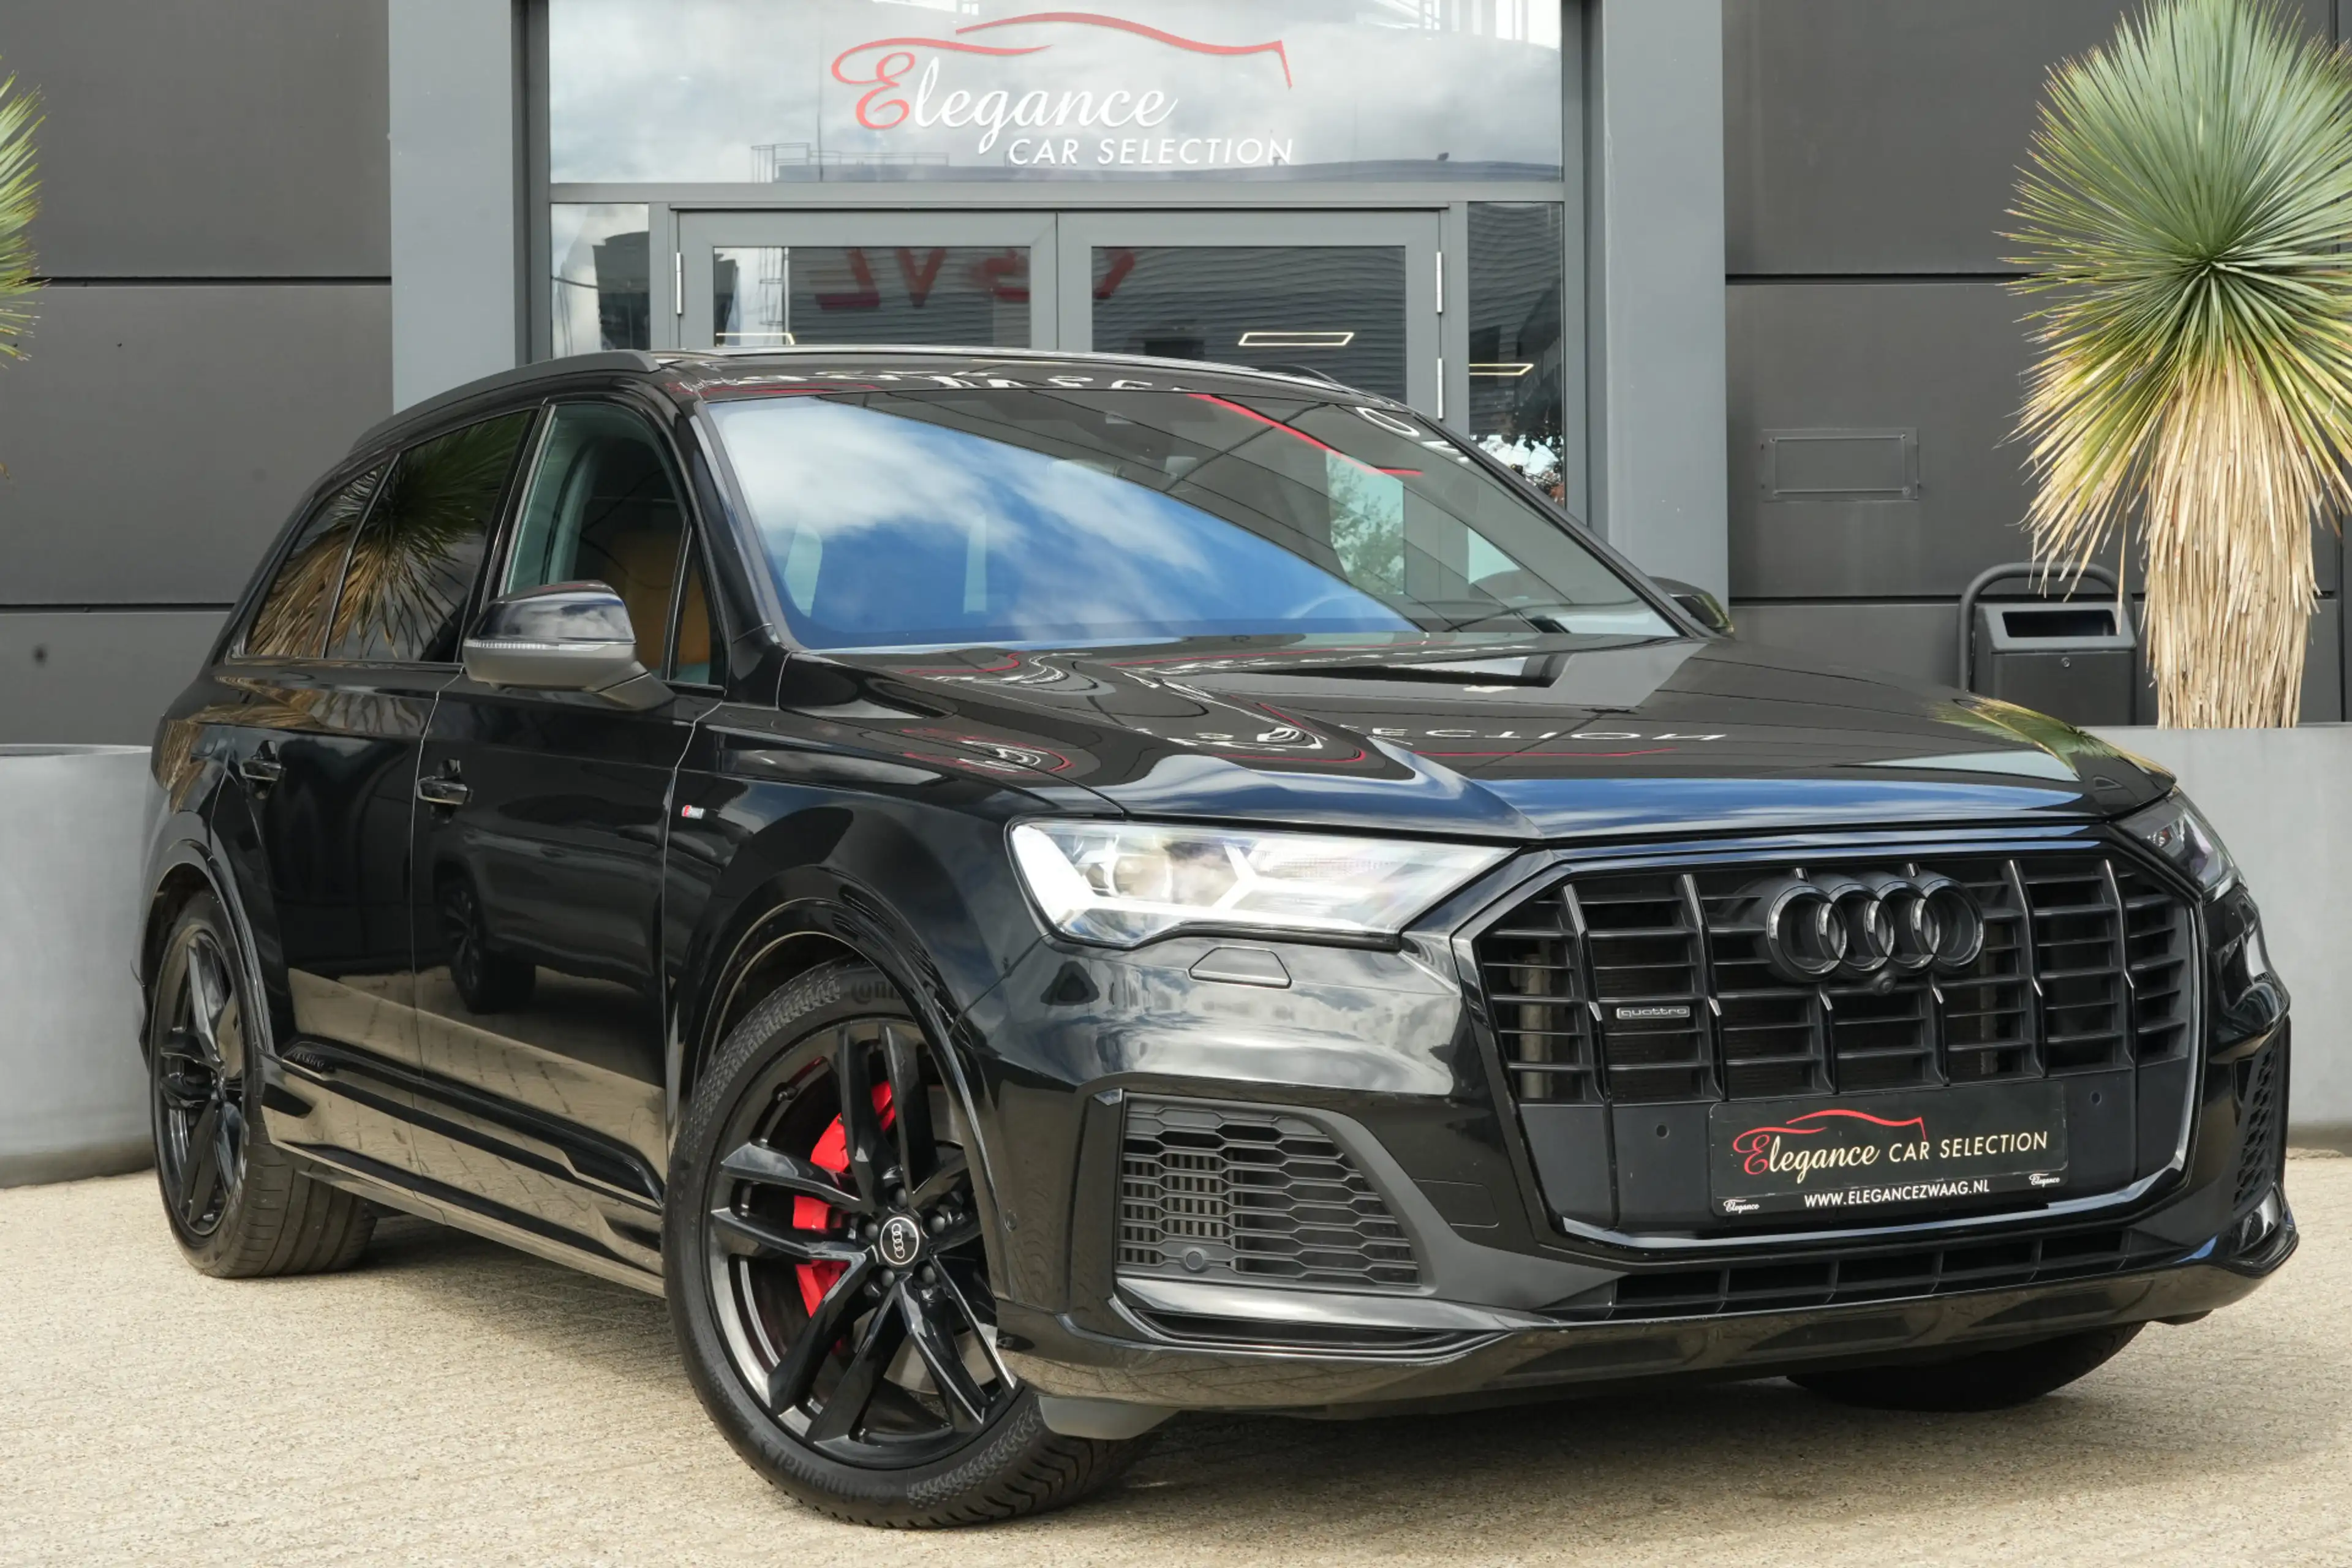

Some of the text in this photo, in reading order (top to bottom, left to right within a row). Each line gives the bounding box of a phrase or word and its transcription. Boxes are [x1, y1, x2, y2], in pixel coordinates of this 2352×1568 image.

[831, 38, 1178, 155] Elegance
[1009, 138, 1293, 165] CAR SELECTION
[1621, 1008, 1687, 1017] quattro
[1733, 1127, 2049, 1184] Elegance CAR SELECTION
[1804, 1178, 1991, 1208] WWW.ELEGANCEZWAAG.NL
